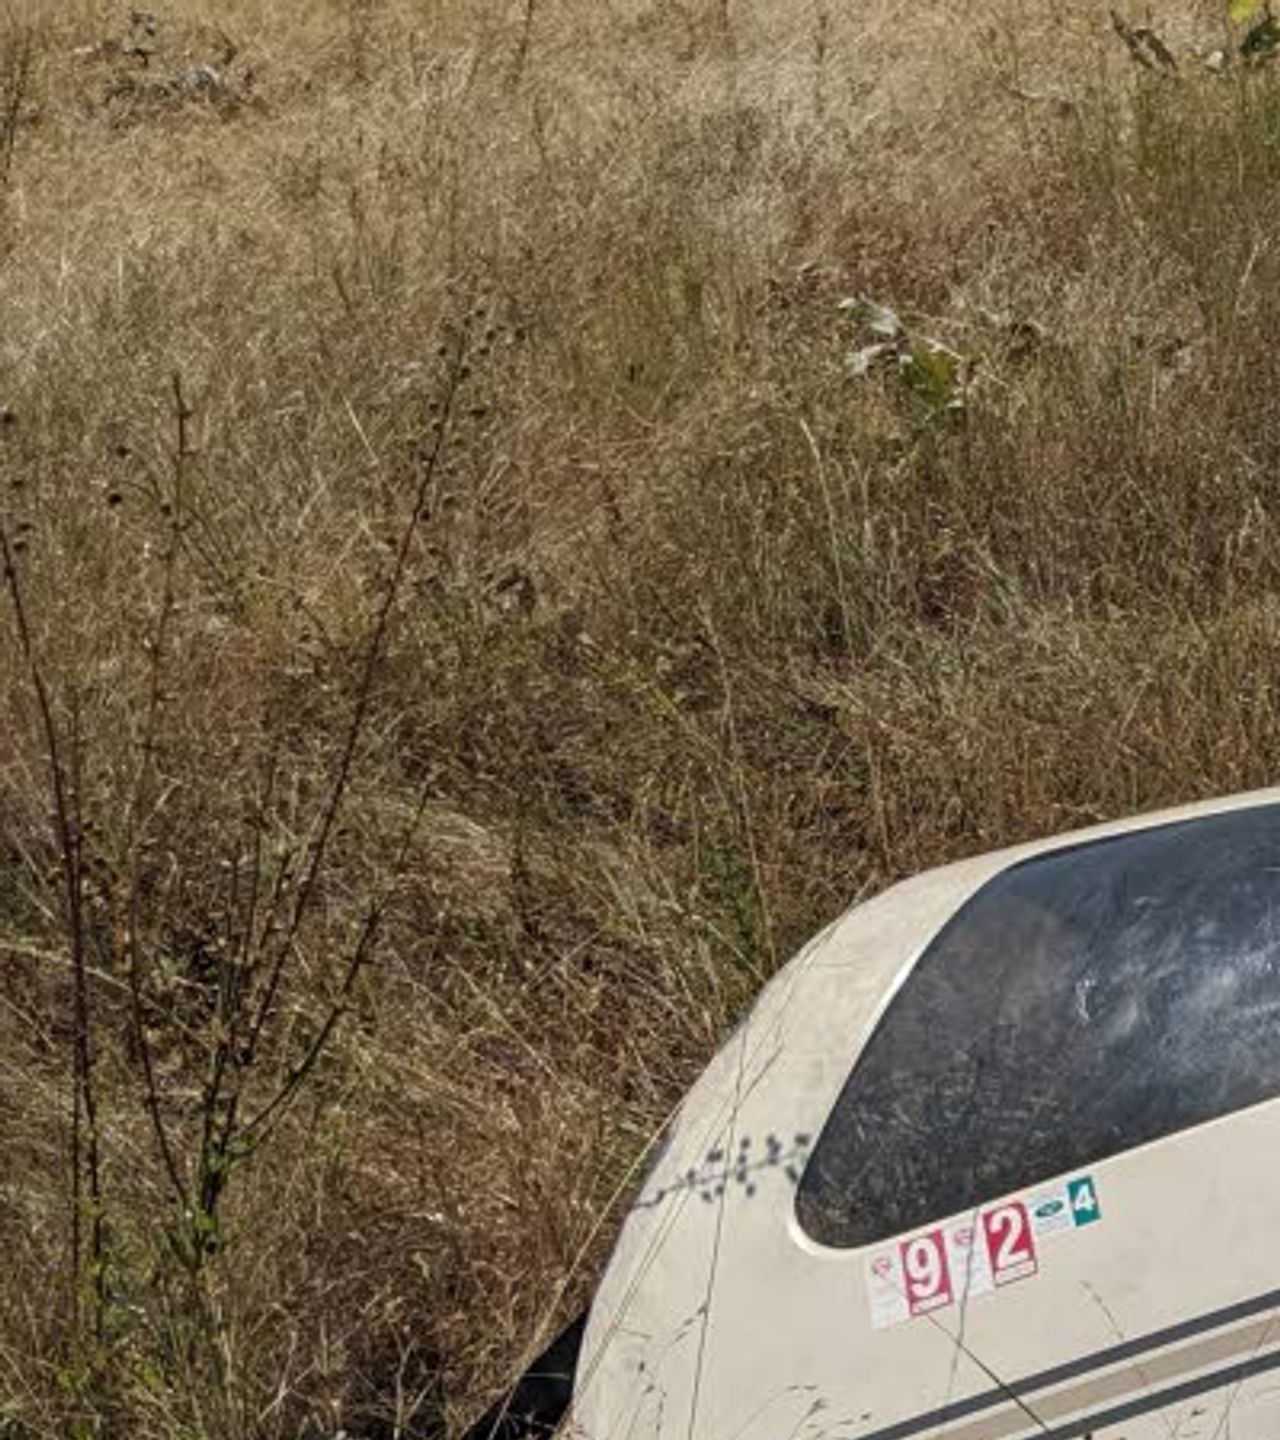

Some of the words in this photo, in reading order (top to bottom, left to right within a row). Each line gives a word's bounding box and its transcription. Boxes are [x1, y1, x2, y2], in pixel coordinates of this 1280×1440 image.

[906, 1238, 942, 1297] 9
[990, 1208, 1029, 1269] 2
[1074, 1183, 1096, 1211] 4
